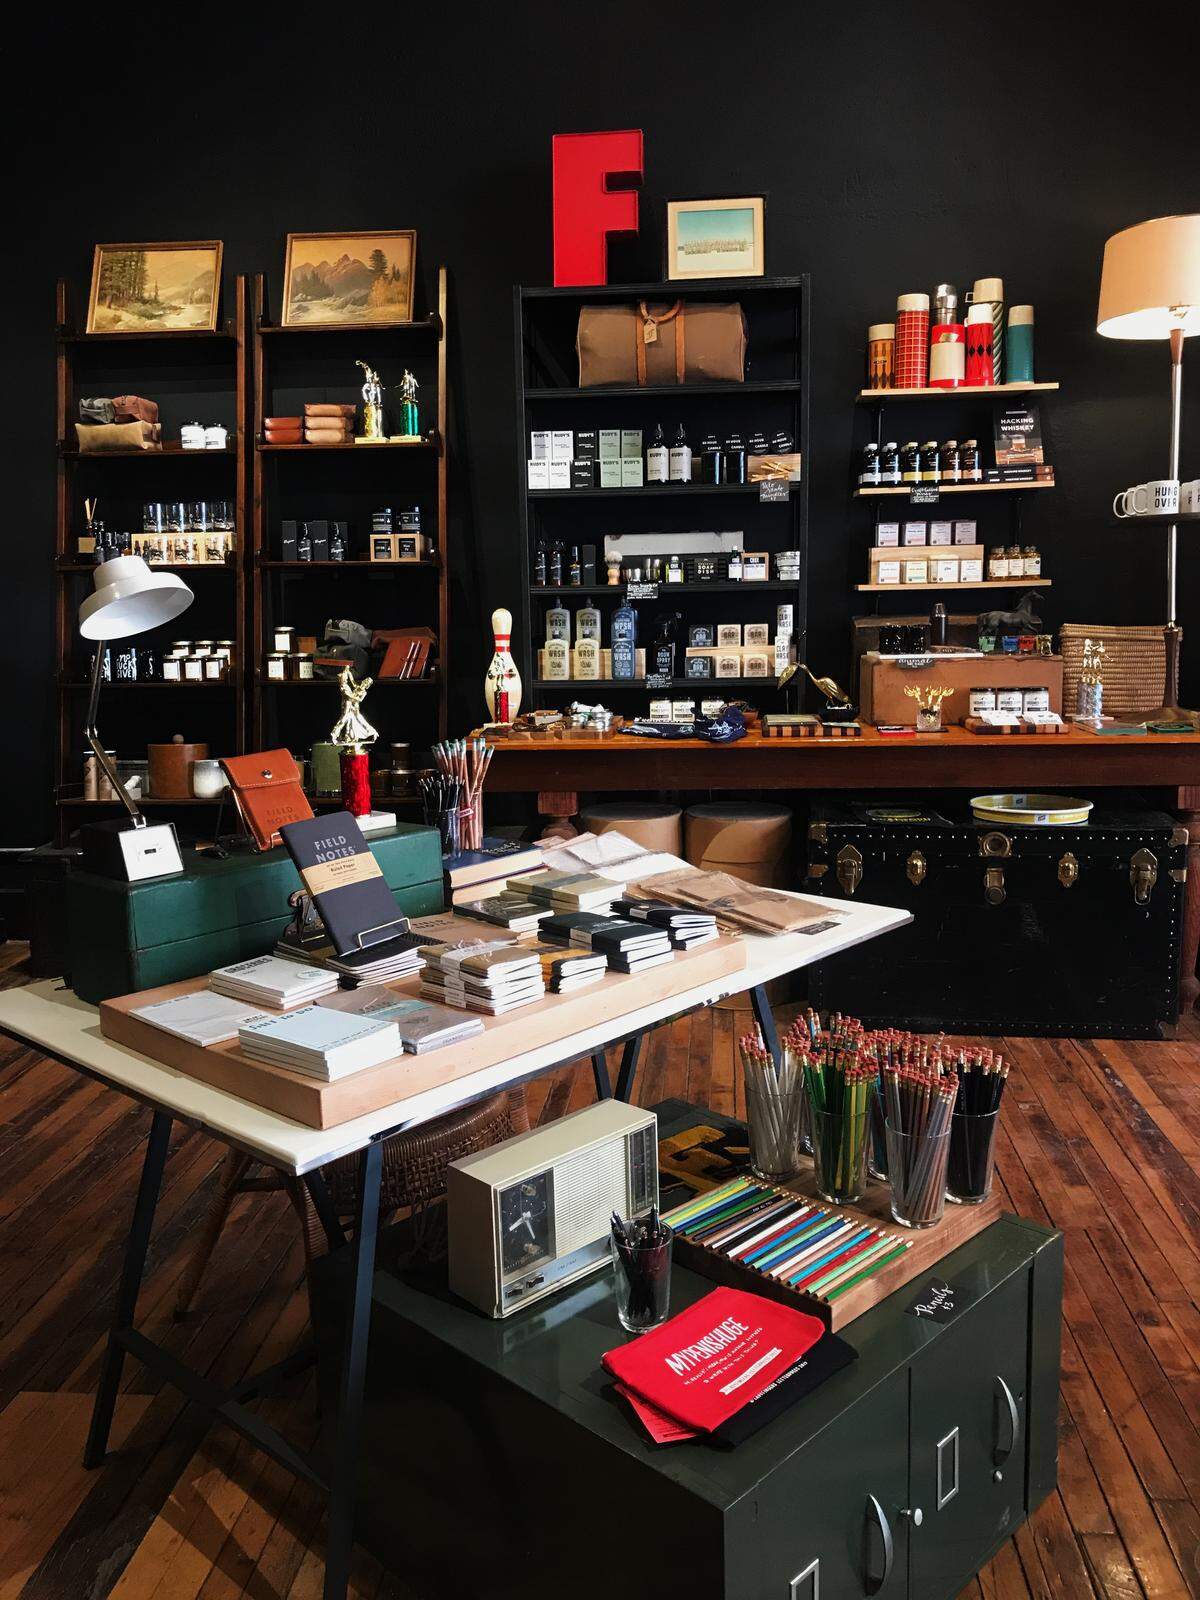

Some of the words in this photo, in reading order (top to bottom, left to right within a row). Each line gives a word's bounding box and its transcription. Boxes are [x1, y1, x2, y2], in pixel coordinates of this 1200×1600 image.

[552, 128, 644, 287] F
[1000, 424, 1034, 432] WHISKEY
[314, 835, 346, 850] FIELD
[315, 846, 356, 863] NOTES
[914, 1280, 954, 1316] Pencils
[940, 1302, 954, 1311] $3
[664, 1316, 749, 1376] MYPENISHUGE
